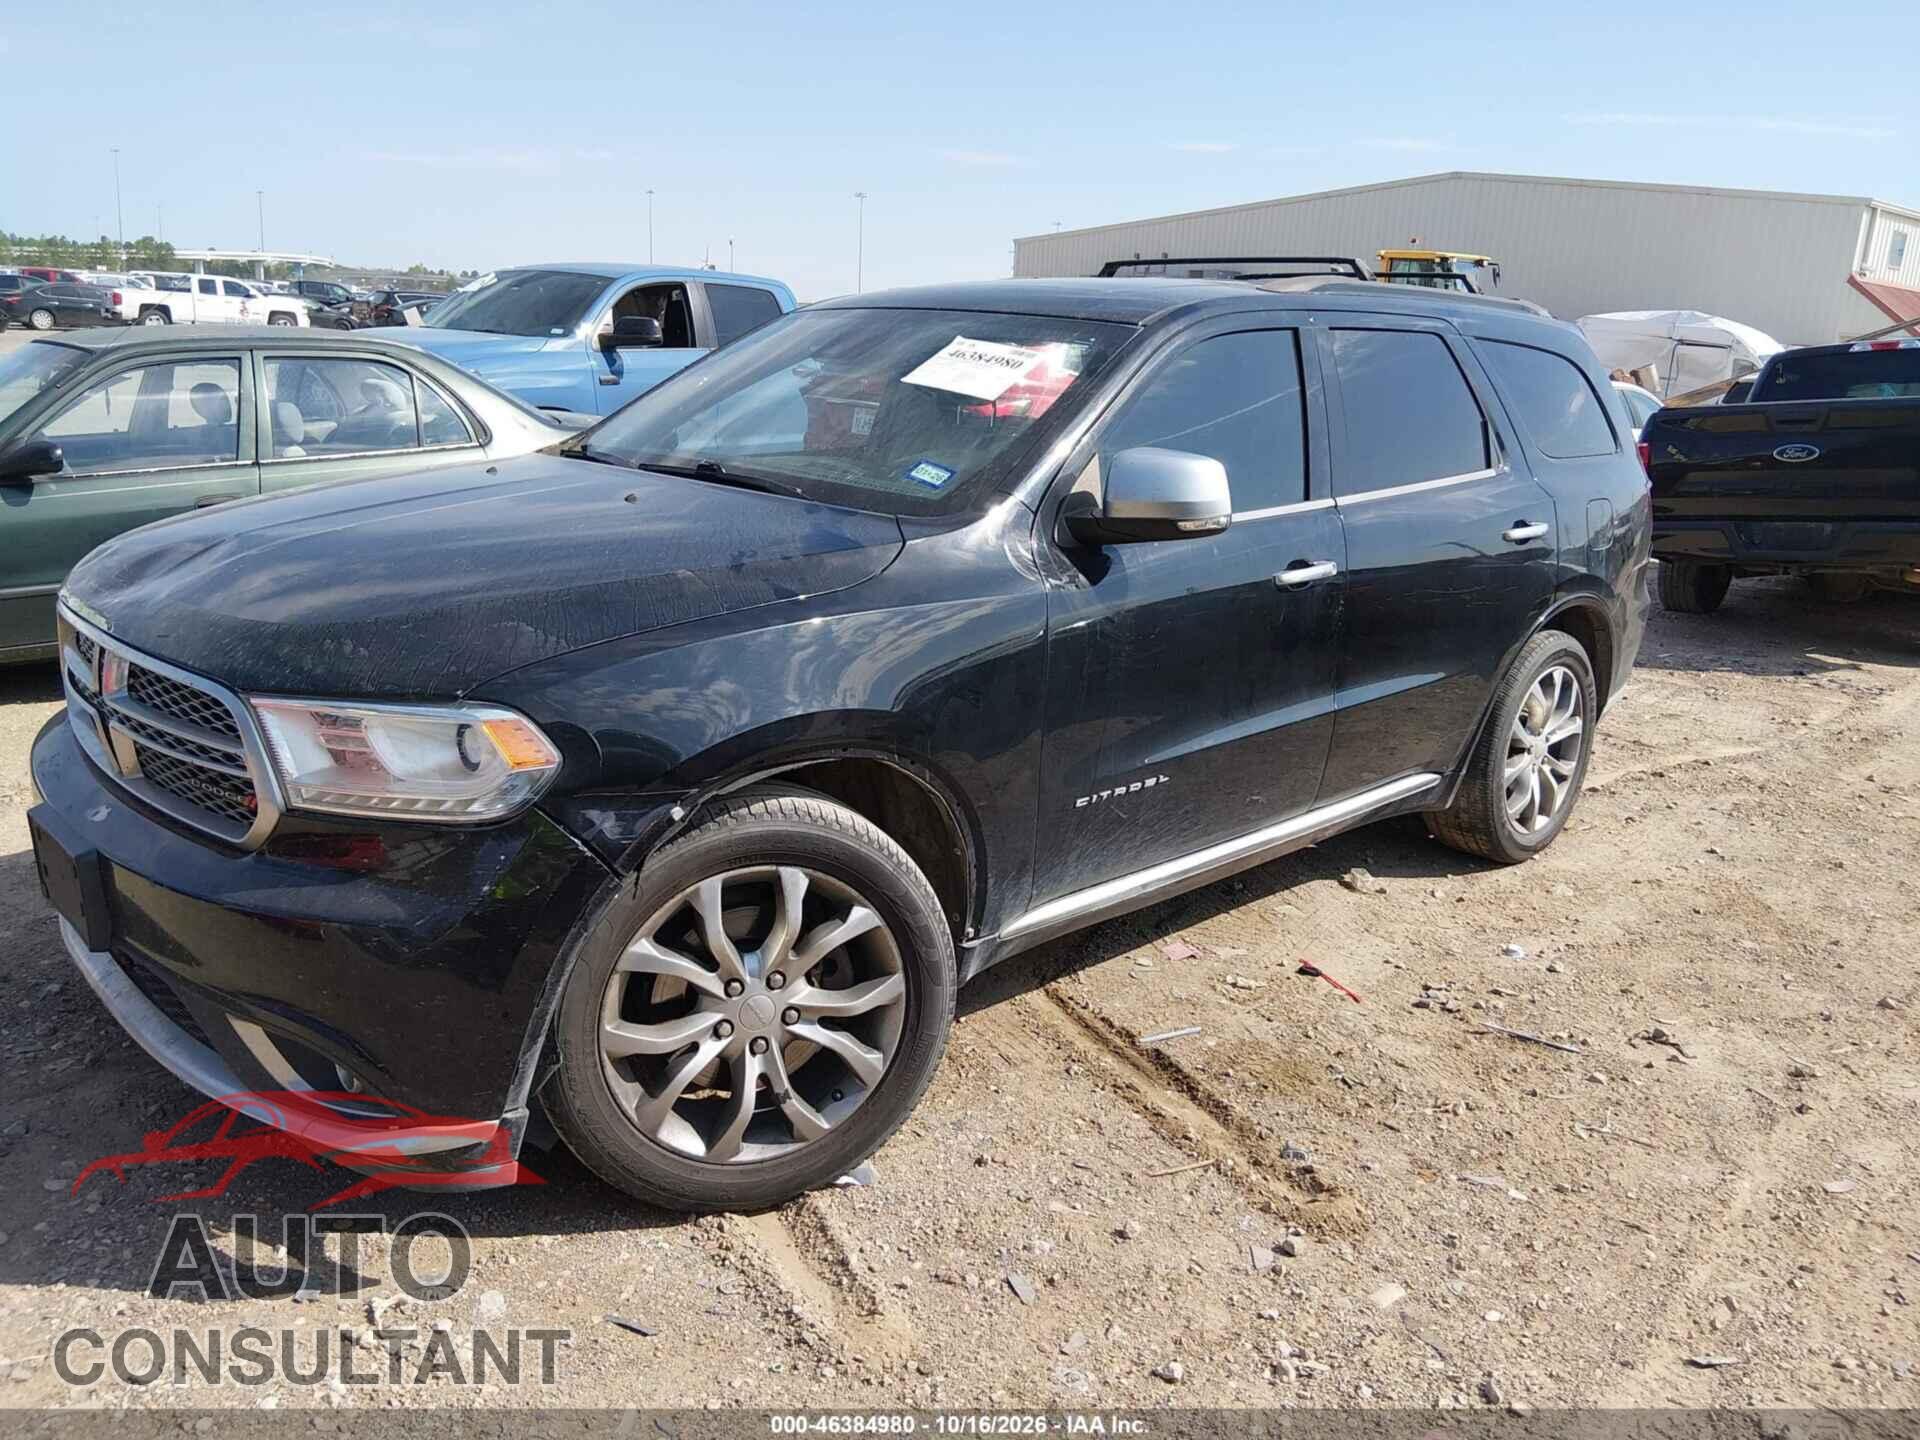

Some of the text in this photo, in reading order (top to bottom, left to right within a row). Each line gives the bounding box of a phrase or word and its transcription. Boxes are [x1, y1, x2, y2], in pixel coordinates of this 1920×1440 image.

[949, 349, 1025, 369] 46384980
[1783, 447, 1809, 458] Ford
[1075, 774, 1171, 808] CITADEL
